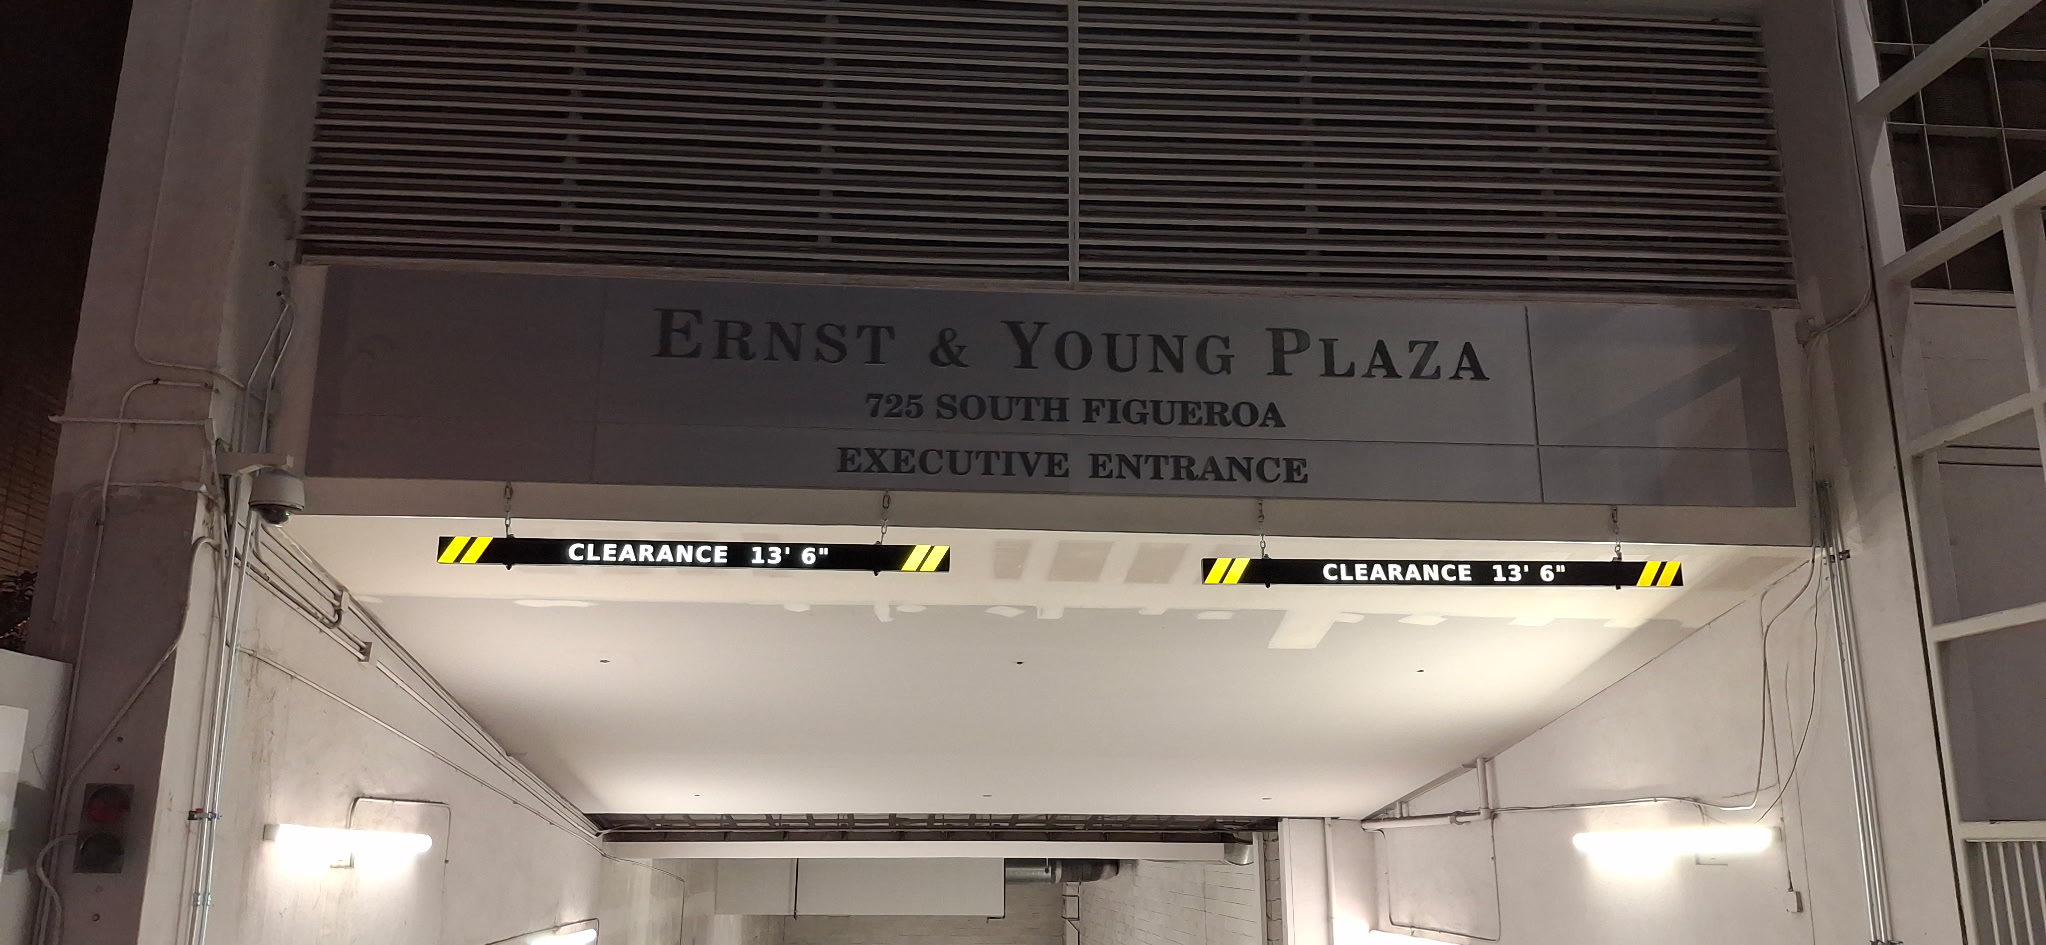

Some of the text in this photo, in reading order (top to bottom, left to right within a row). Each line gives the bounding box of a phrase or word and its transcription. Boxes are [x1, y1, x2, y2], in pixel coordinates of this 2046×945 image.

[652, 308, 1491, 382] ERNST & YOUNG PLAZA
[865, 392, 1287, 428] 725 SOUTH FIGUEROA
[836, 446, 1309, 485] EXECUTIVE ENTRANCE
[567, 542, 830, 565] CLEARANCE 13' 6"
[1322, 562, 1566, 583] CLEARANCE 13' 6"
